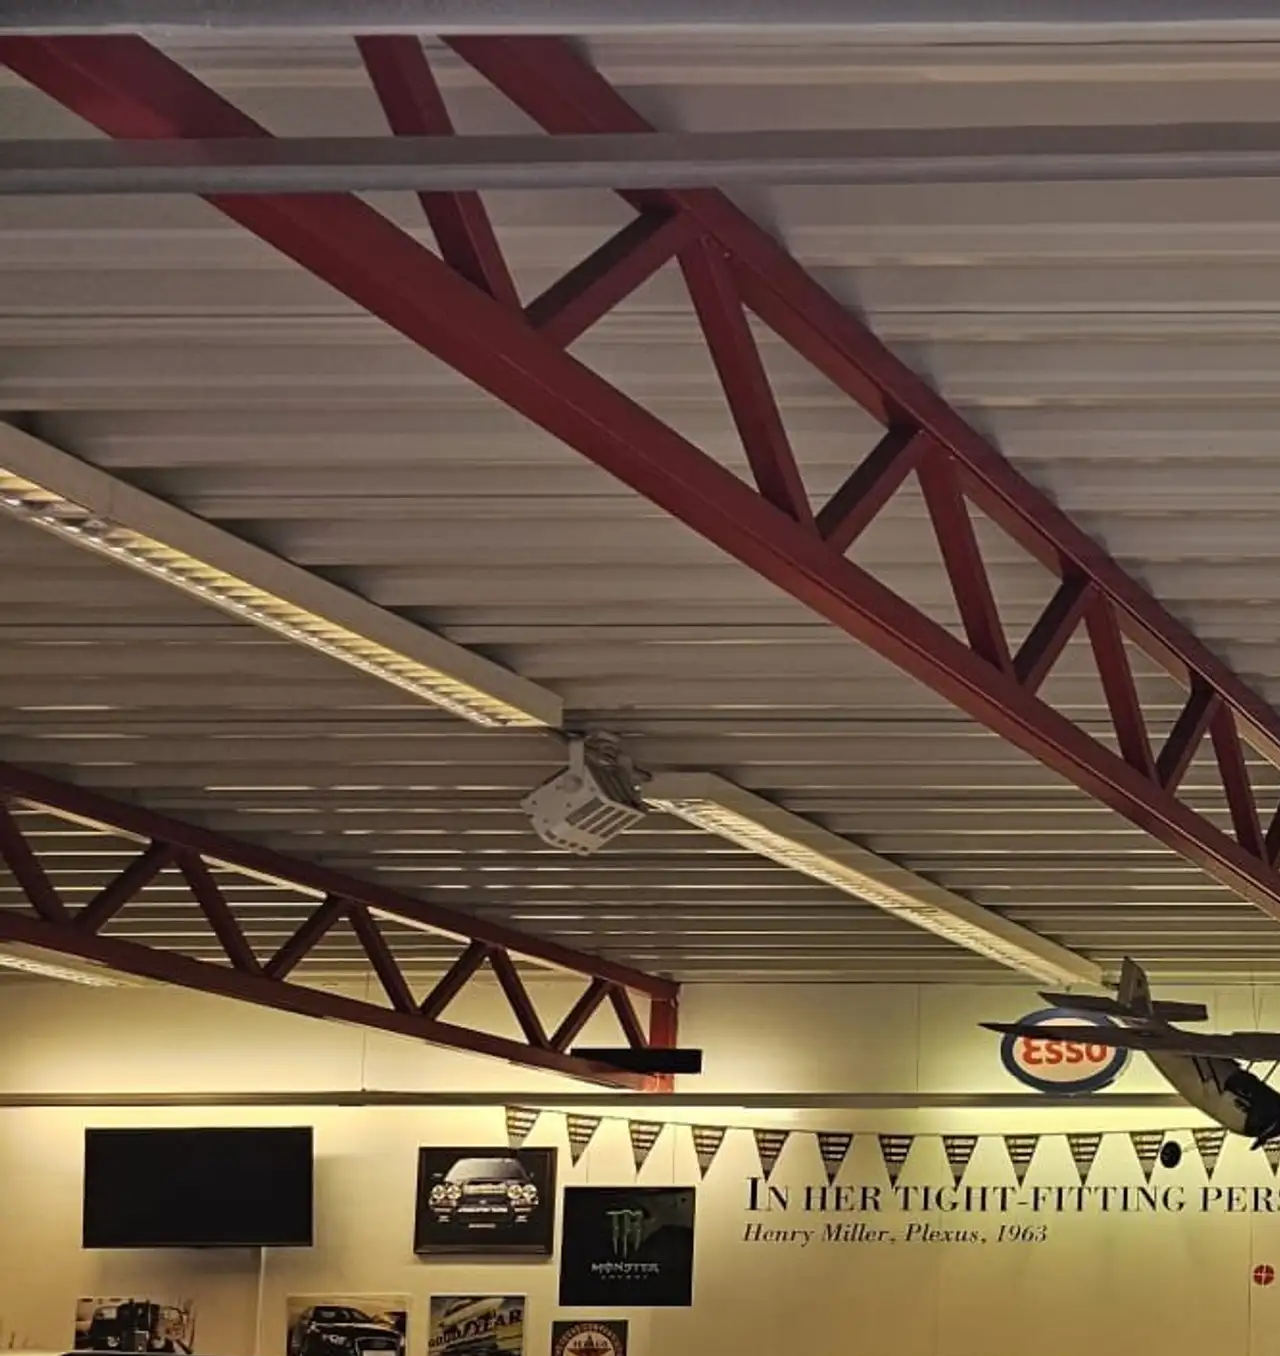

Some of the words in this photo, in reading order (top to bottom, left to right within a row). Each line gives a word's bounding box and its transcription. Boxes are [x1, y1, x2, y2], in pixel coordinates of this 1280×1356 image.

[744, 1176, 788, 1212] IN
[803, 1186, 882, 1212] HER
[894, 1185, 1186, 1212] TIGHT-FITTING
[742, 1223, 814, 1246] Henry
[822, 1223, 896, 1244] Miller,
[904, 1223, 987, 1244] Plexus,
[996, 1224, 1048, 1243] 1963
[591, 1262, 660, 1273] MONSTER
